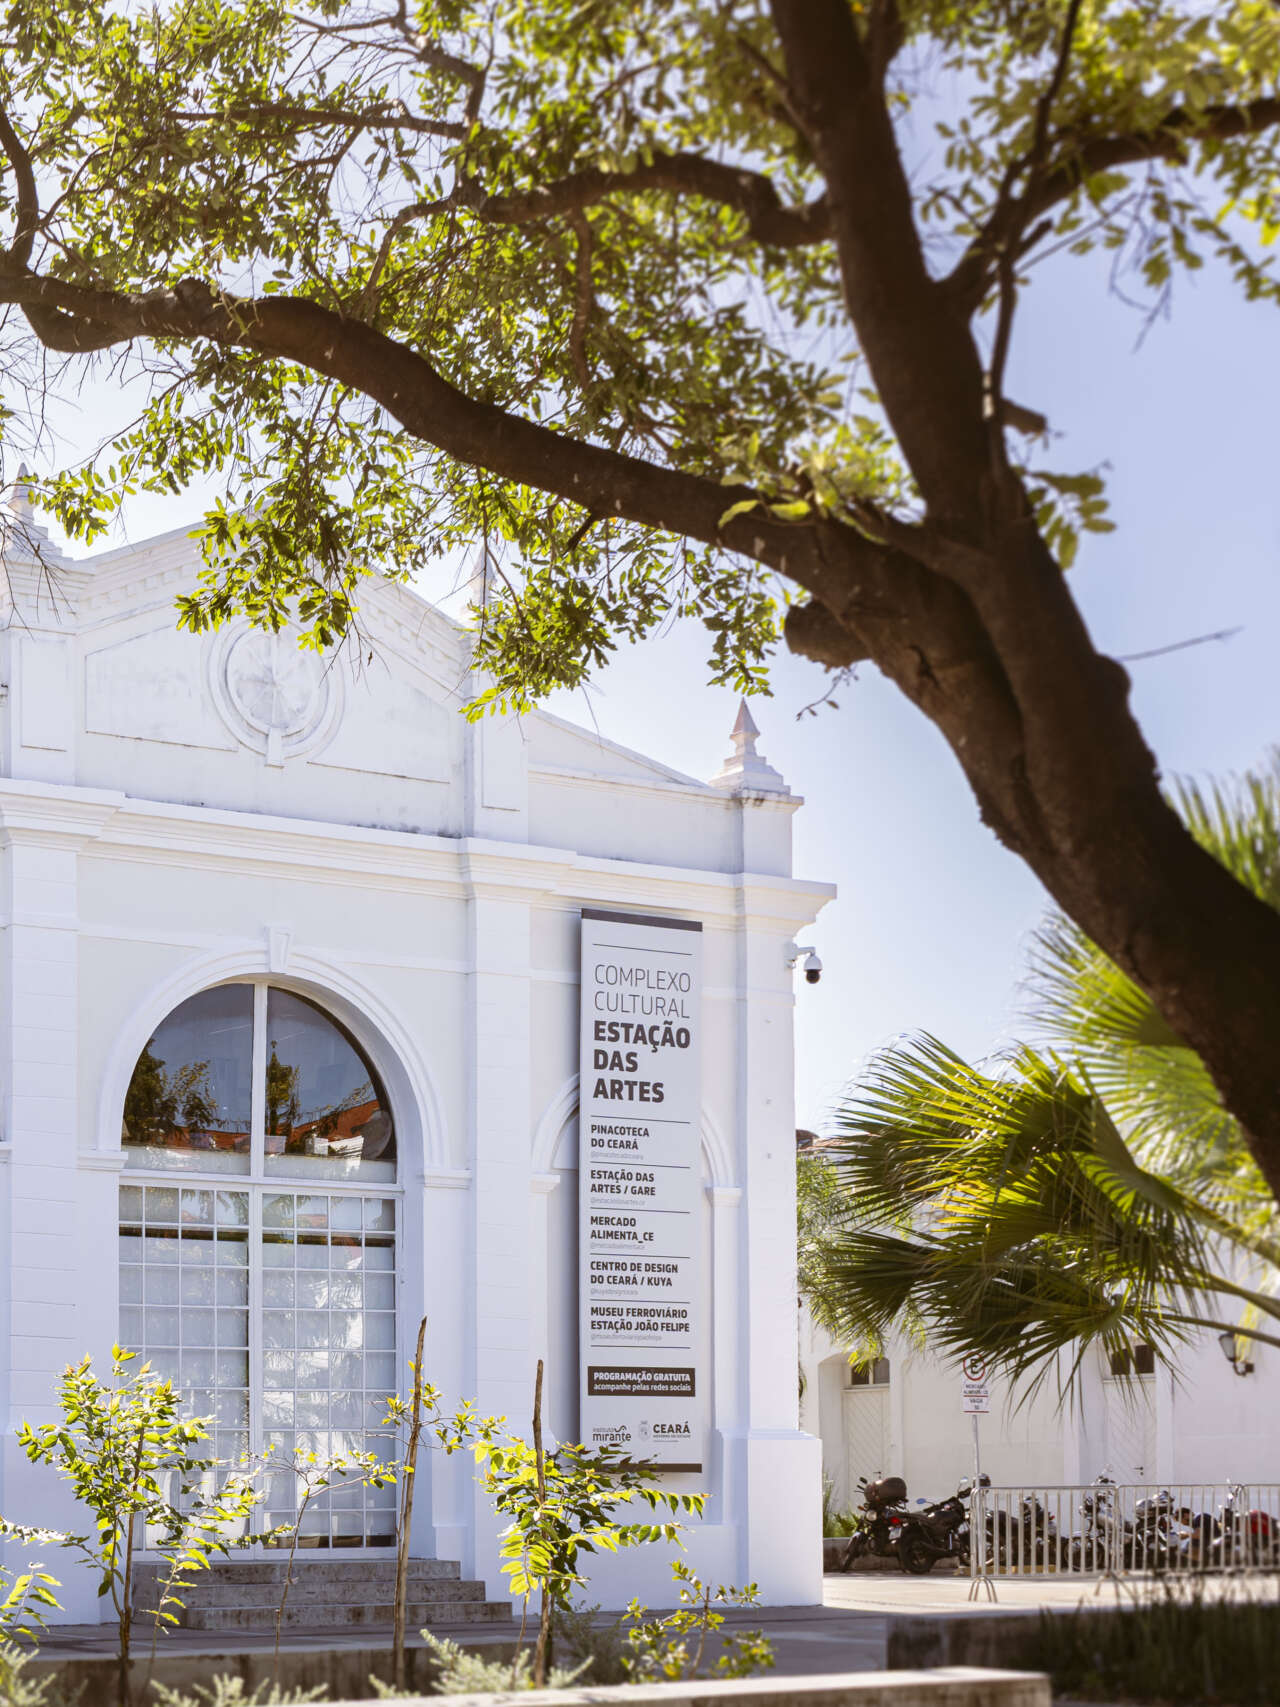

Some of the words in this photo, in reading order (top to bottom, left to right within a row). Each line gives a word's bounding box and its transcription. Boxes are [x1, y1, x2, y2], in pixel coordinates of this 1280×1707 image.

[594, 964, 691, 992] COMPLEXO
[594, 991, 690, 1019] CULTURAL
[594, 1020, 691, 1052] ESTAÇÃO
[593, 1049, 638, 1073] DAS
[593, 1078, 664, 1103] ARTES
[591, 1125, 649, 1137] PINACOTECA
[591, 1138, 604, 1148] DO
[607, 1138, 639, 1150] CEARÁ
[590, 1169, 633, 1183] ESTAÇÃO
[636, 1172, 654, 1182] DAS
[590, 1184, 621, 1194] ARTES
[630, 1186, 656, 1195] GARE
[590, 1216, 637, 1227] MERCADO
[590, 1230, 654, 1244] ALIMENTA_CE
[590, 1261, 627, 1271] CENTRO
[630, 1263, 642, 1272] DE
[644, 1263, 678, 1273] DESIGN
[590, 1275, 604, 1284] DO
[606, 1274, 638, 1285] CEARÁ
[647, 1276, 673, 1286] KUYA
[590, 1307, 624, 1317] MUSEU
[626, 1307, 688, 1319] FERROVIÁRIO
[590, 1319, 633, 1333] ESTAÇÃO
[634, 1320, 659, 1331] JOÃO
[660, 1322, 690, 1332] FELIPE
[593, 1371, 652, 1383] PROGRAMAÇÃO
[653, 1373, 691, 1382] GRATUITA
[593, 1384, 631, 1392] acompanhe
[632, 1384, 650, 1392] pelas
[653, 1421, 691, 1434] CEARÁ
[592, 1433, 631, 1441] mirante
